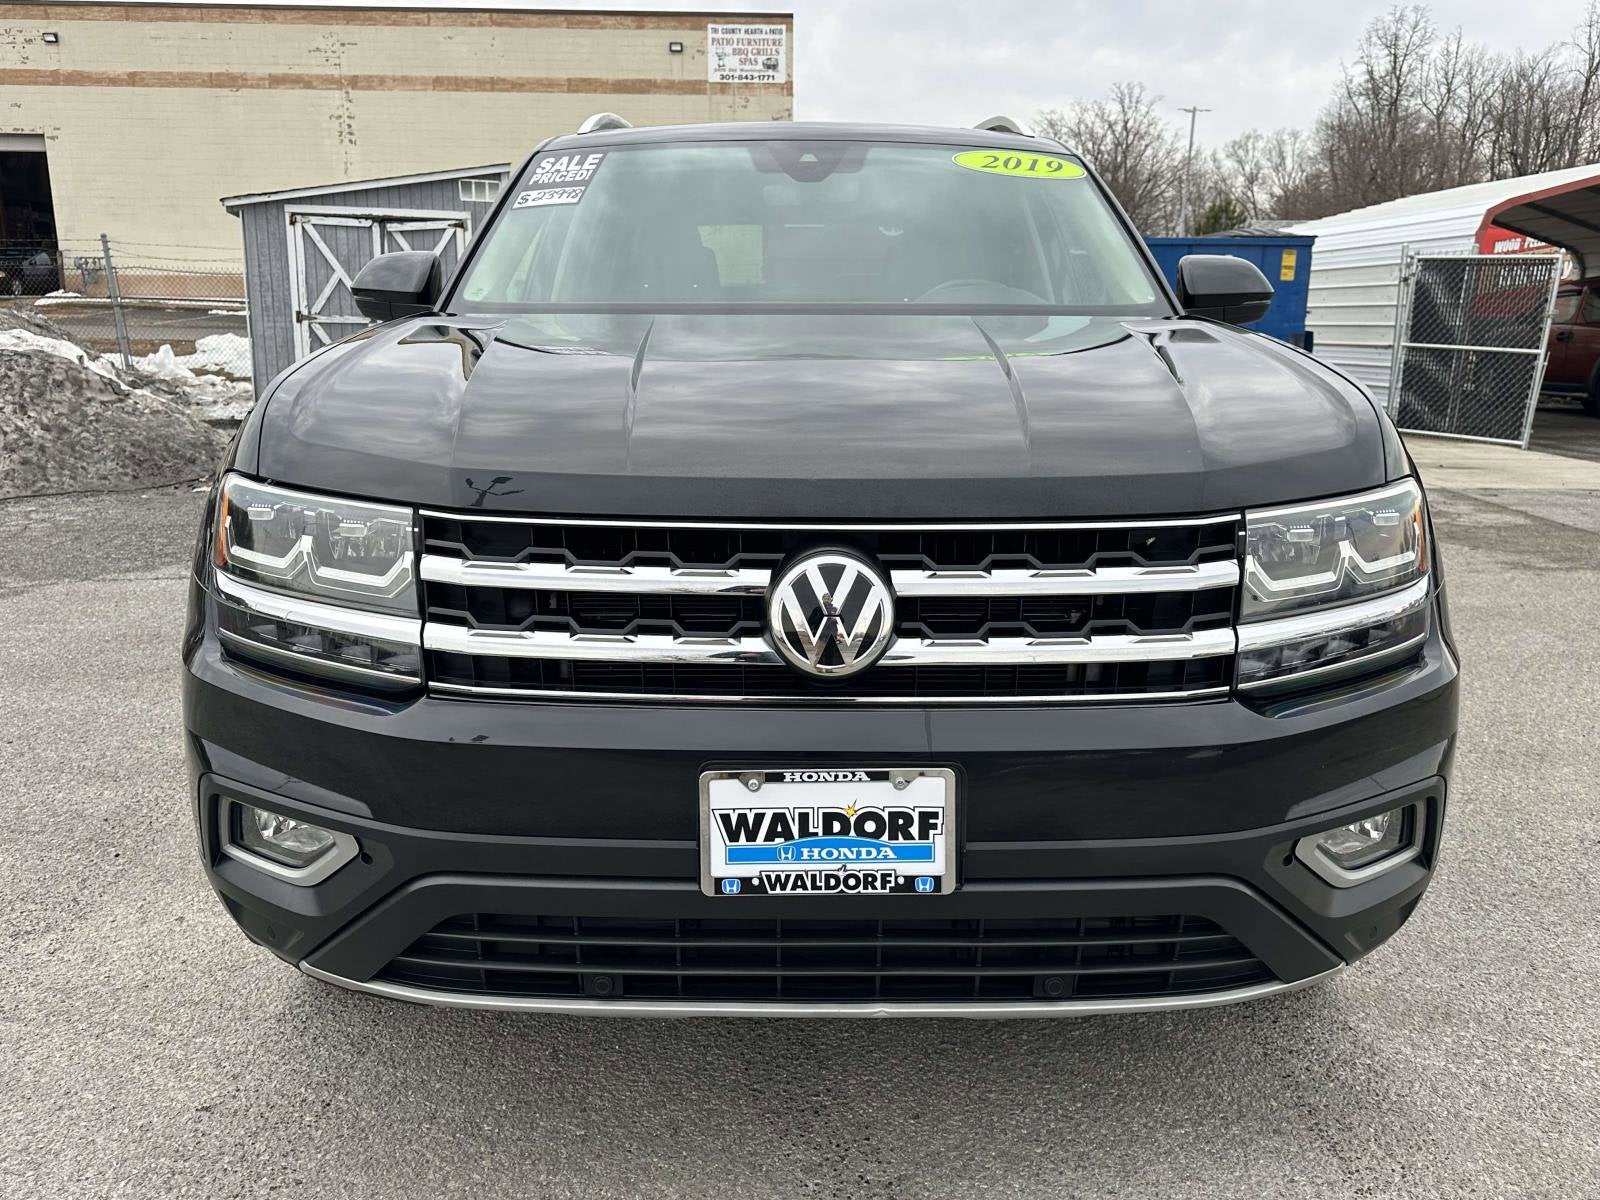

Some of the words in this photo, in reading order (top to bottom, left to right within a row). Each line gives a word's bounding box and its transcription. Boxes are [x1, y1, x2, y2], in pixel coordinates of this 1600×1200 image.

[711, 37, 735, 46] PATIO
[736, 38, 783, 46] FURNITURE
[732, 48, 749, 57] BBQ
[751, 48, 780, 56] GRILLS
[739, 57, 758, 66] SPAS
[535, 153, 604, 174] SALE
[981, 155, 1063, 172] 2019
[528, 169, 593, 185] PRICED!
[1493, 237, 1521, 253] WOOD
[783, 771, 870, 782] HONDA
[713, 806, 944, 845] WALDORF
[800, 847, 897, 860] HONDA
[761, 869, 897, 894] WALDORF
